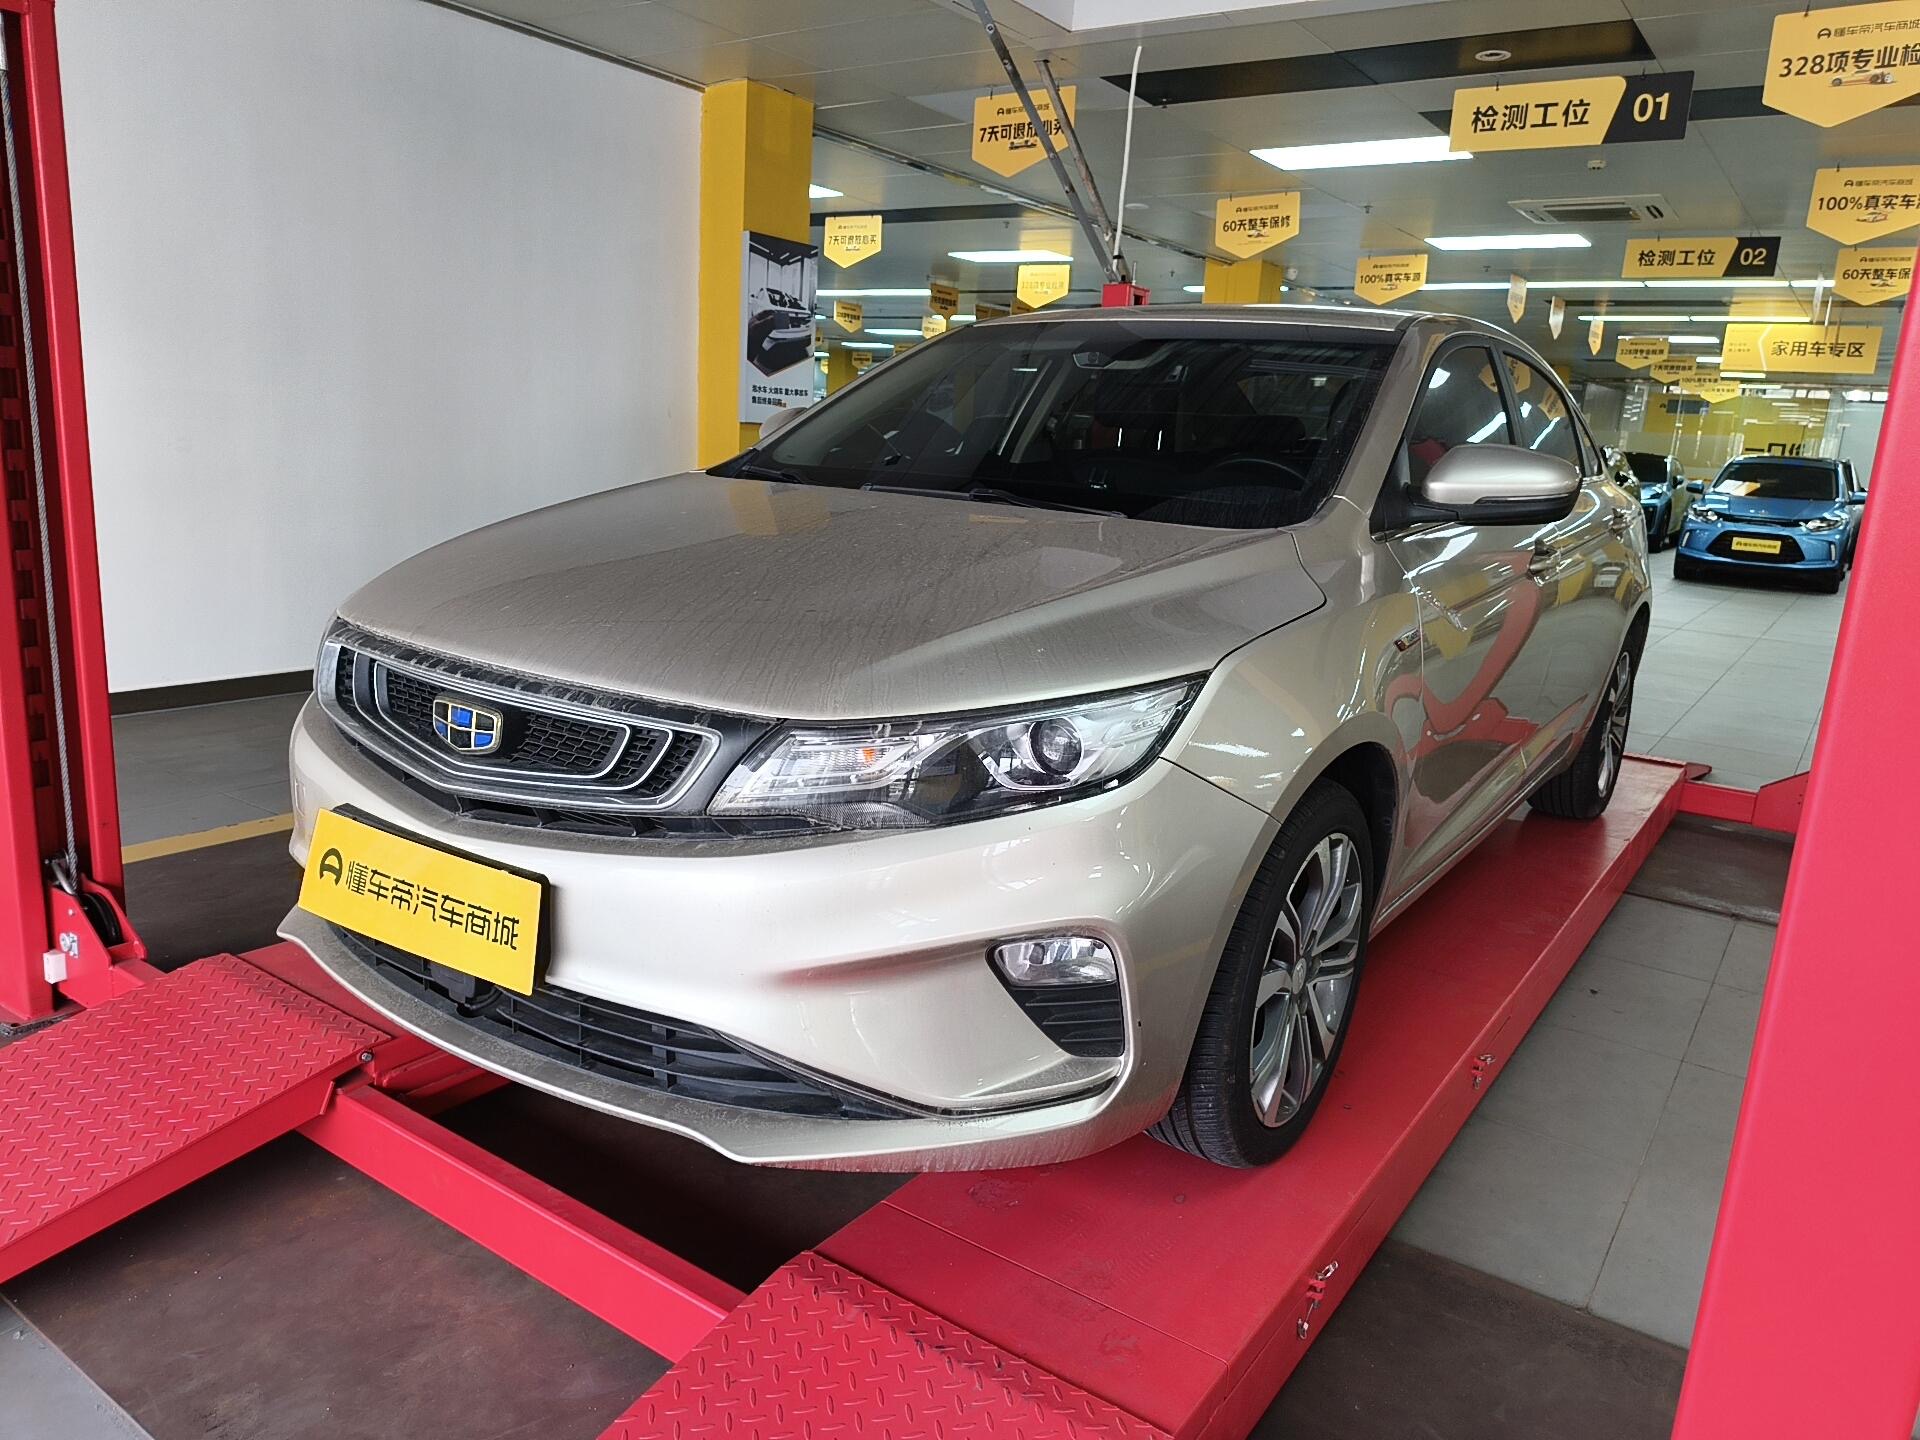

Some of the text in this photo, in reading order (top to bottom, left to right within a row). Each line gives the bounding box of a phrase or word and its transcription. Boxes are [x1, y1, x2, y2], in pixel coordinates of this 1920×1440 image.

[1471, 92, 1670, 133] 检测工位 01
[1817, 194, 1920, 211] 100%真实车
[1222, 215, 1291, 233] 60天整车保修
[1638, 248, 1767, 267] 检测工位 02
[1771, 340, 1866, 358] 家用车专区
[345, 860, 520, 951] 懂车帝汽车商城
